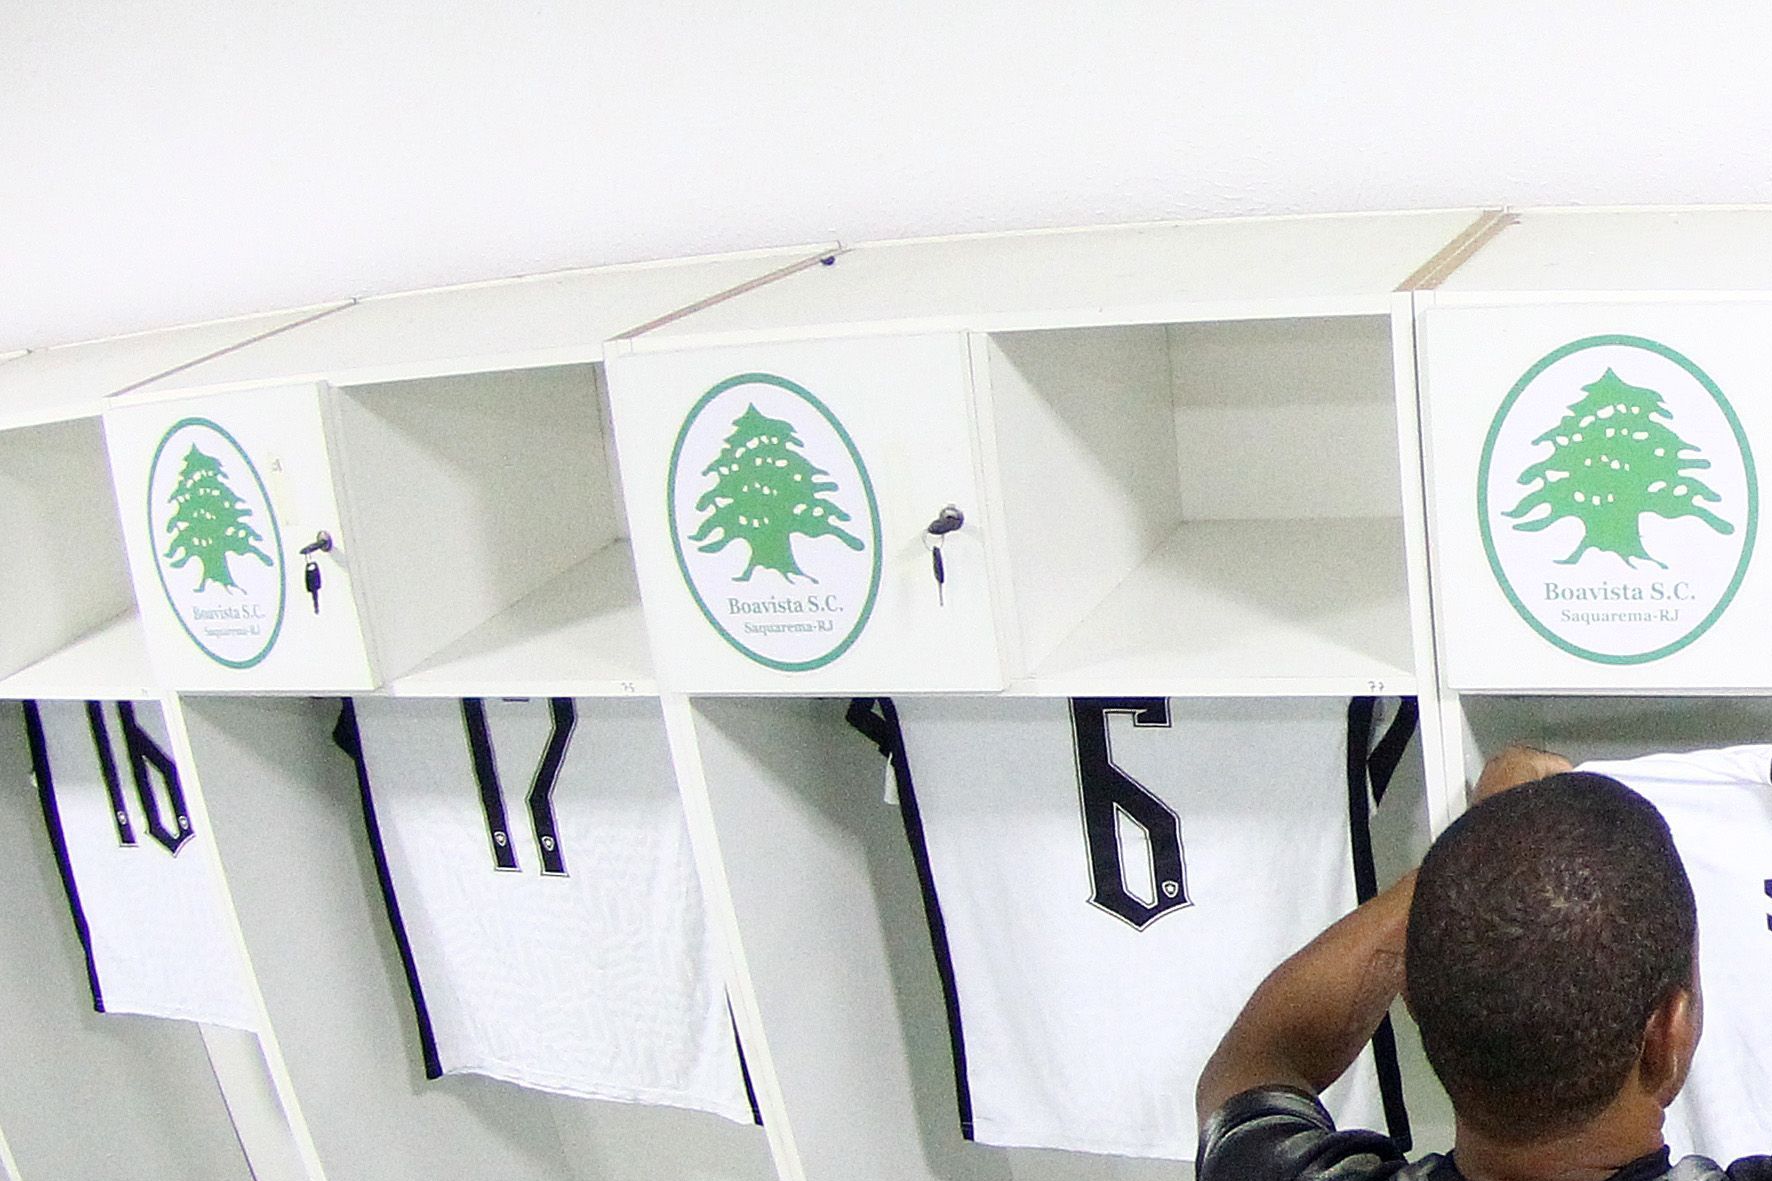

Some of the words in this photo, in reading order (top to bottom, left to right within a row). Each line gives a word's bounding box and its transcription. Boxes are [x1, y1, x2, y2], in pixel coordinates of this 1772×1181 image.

[1544, 581, 1643, 601] Boavista
[1650, 581, 1696, 601] S.C.
[193, 604, 240, 620] Boavista
[728, 595, 803, 615] Boavista
[807, 594, 844, 613] S.C.
[1560, 608, 1680, 625] Saquarema-RJ
[743, 619, 834, 636] Saquarema-RJ
[1068, 697, 1195, 933] 6
